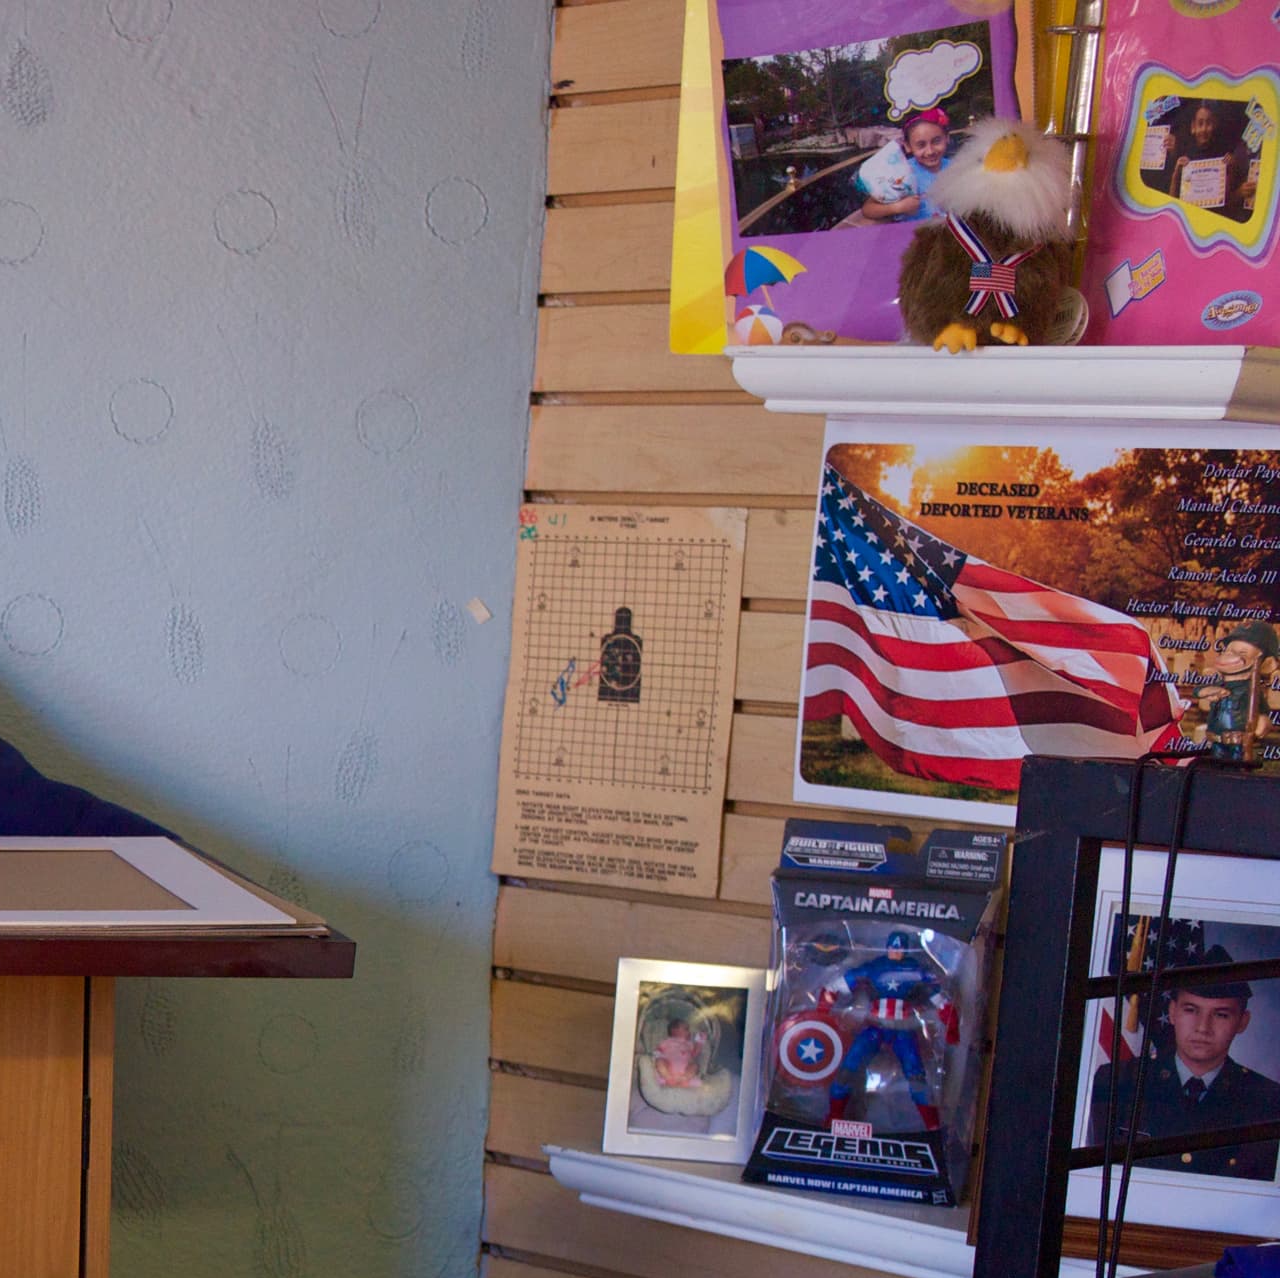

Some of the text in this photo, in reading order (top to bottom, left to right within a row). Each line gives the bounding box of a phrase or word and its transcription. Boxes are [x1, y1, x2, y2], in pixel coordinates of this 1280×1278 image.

[1203, 463, 1252, 478] Dordar
[957, 481, 1040, 498] DECEASED
[920, 501, 1090, 523] DEPORTED VETERANS
[1177, 498, 1228, 512] Manuel
[1184, 532, 1236, 548] Gerardo
[1216, 568, 1257, 584] Acedo
[1126, 598, 1272, 619] Hector Manuel Barrios
[1158, 634, 1210, 651] Gonzalo
[1145, 668, 1180, 685] Juan
[790, 837, 827, 849] BUILD
[835, 841, 884, 854] FIGURE
[794, 891, 960, 920] CAPTAIN AMERICA
[832, 1119, 872, 1138] MARVEL
[762, 1127, 939, 1175] LEGENDS
[767, 1172, 924, 1200] MARVEL NOW! CAPTAIN AMERICA
